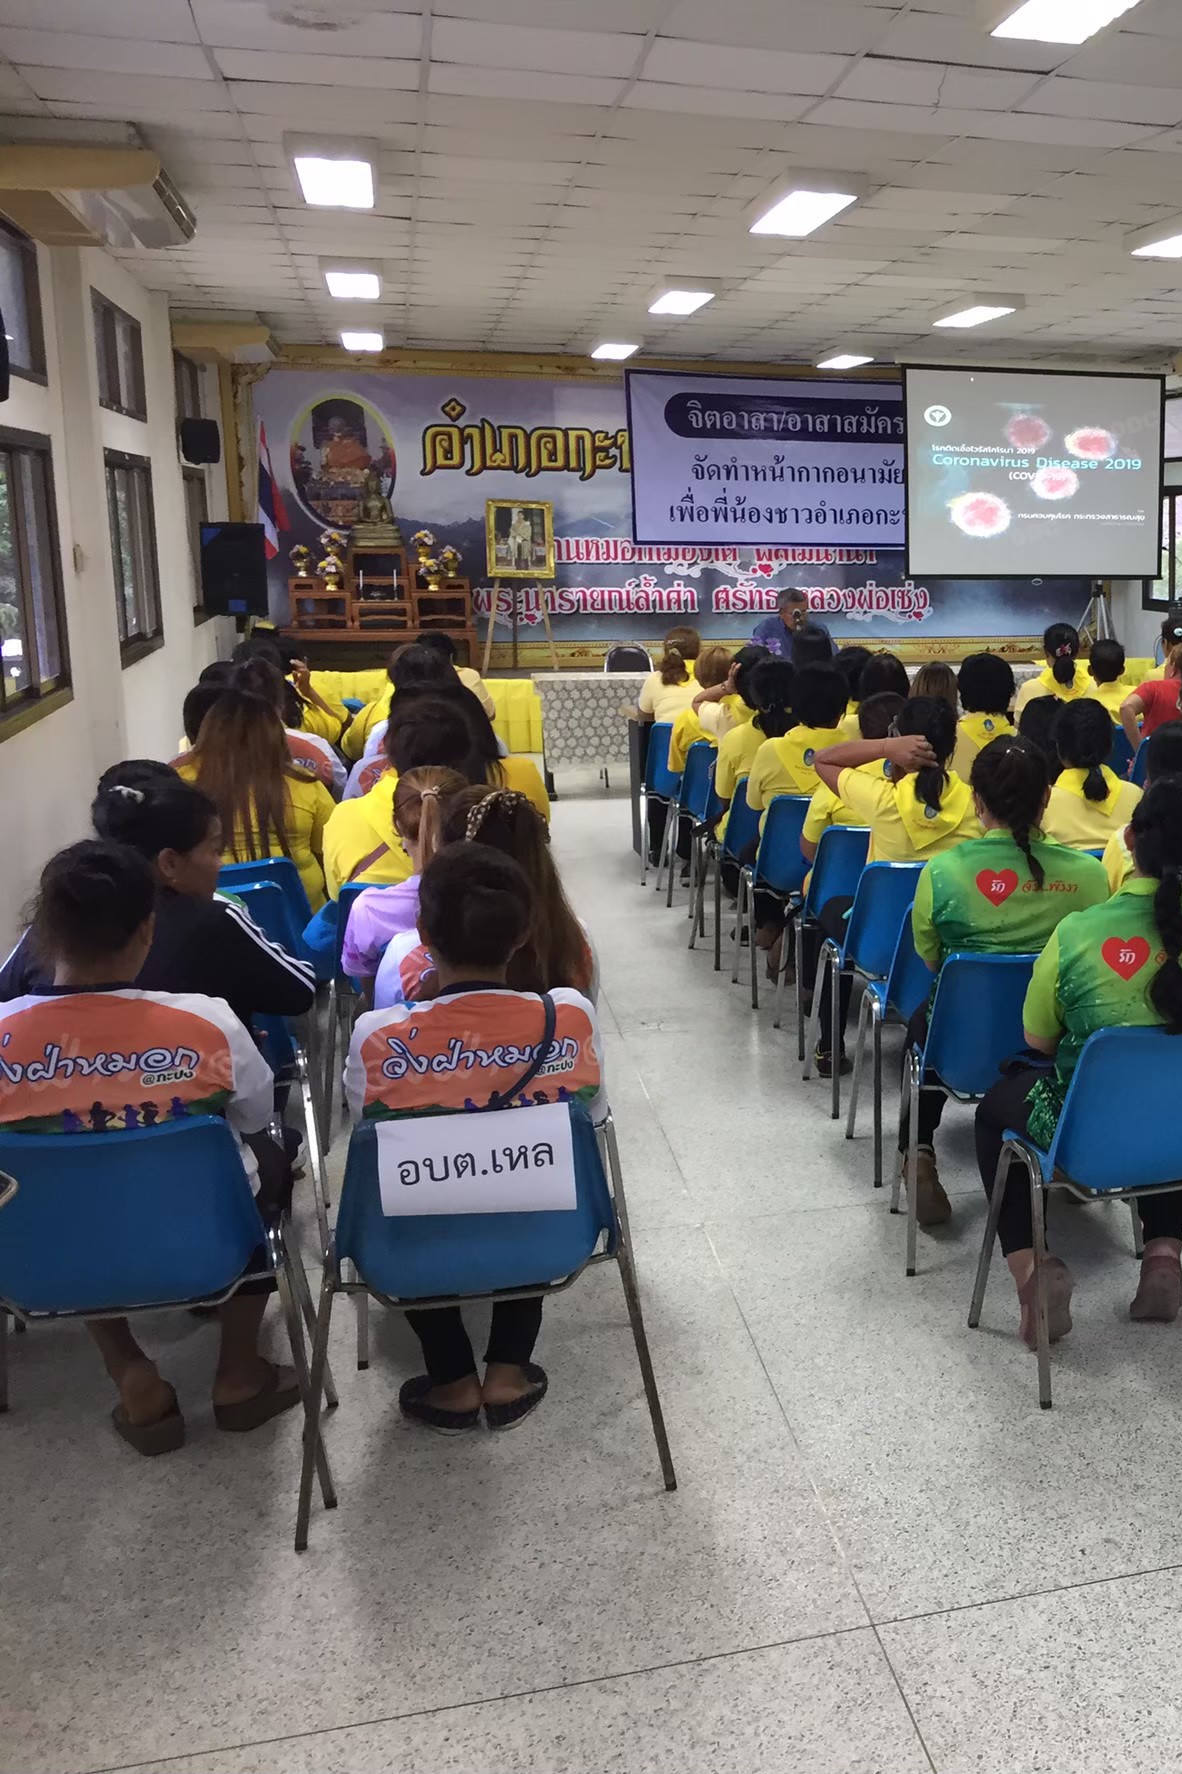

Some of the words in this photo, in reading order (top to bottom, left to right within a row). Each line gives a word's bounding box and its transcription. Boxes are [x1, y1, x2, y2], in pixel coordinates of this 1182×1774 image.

[932, 453, 1030, 468] Coronavirus
[1036, 457, 1098, 470] Disease
[1104, 458, 1142, 470] 2019
[669, 487, 905, 525] เพื่อพี่น้องชาวอำเภอกะ
[397, 1137, 556, 1186] อบต.เหล
